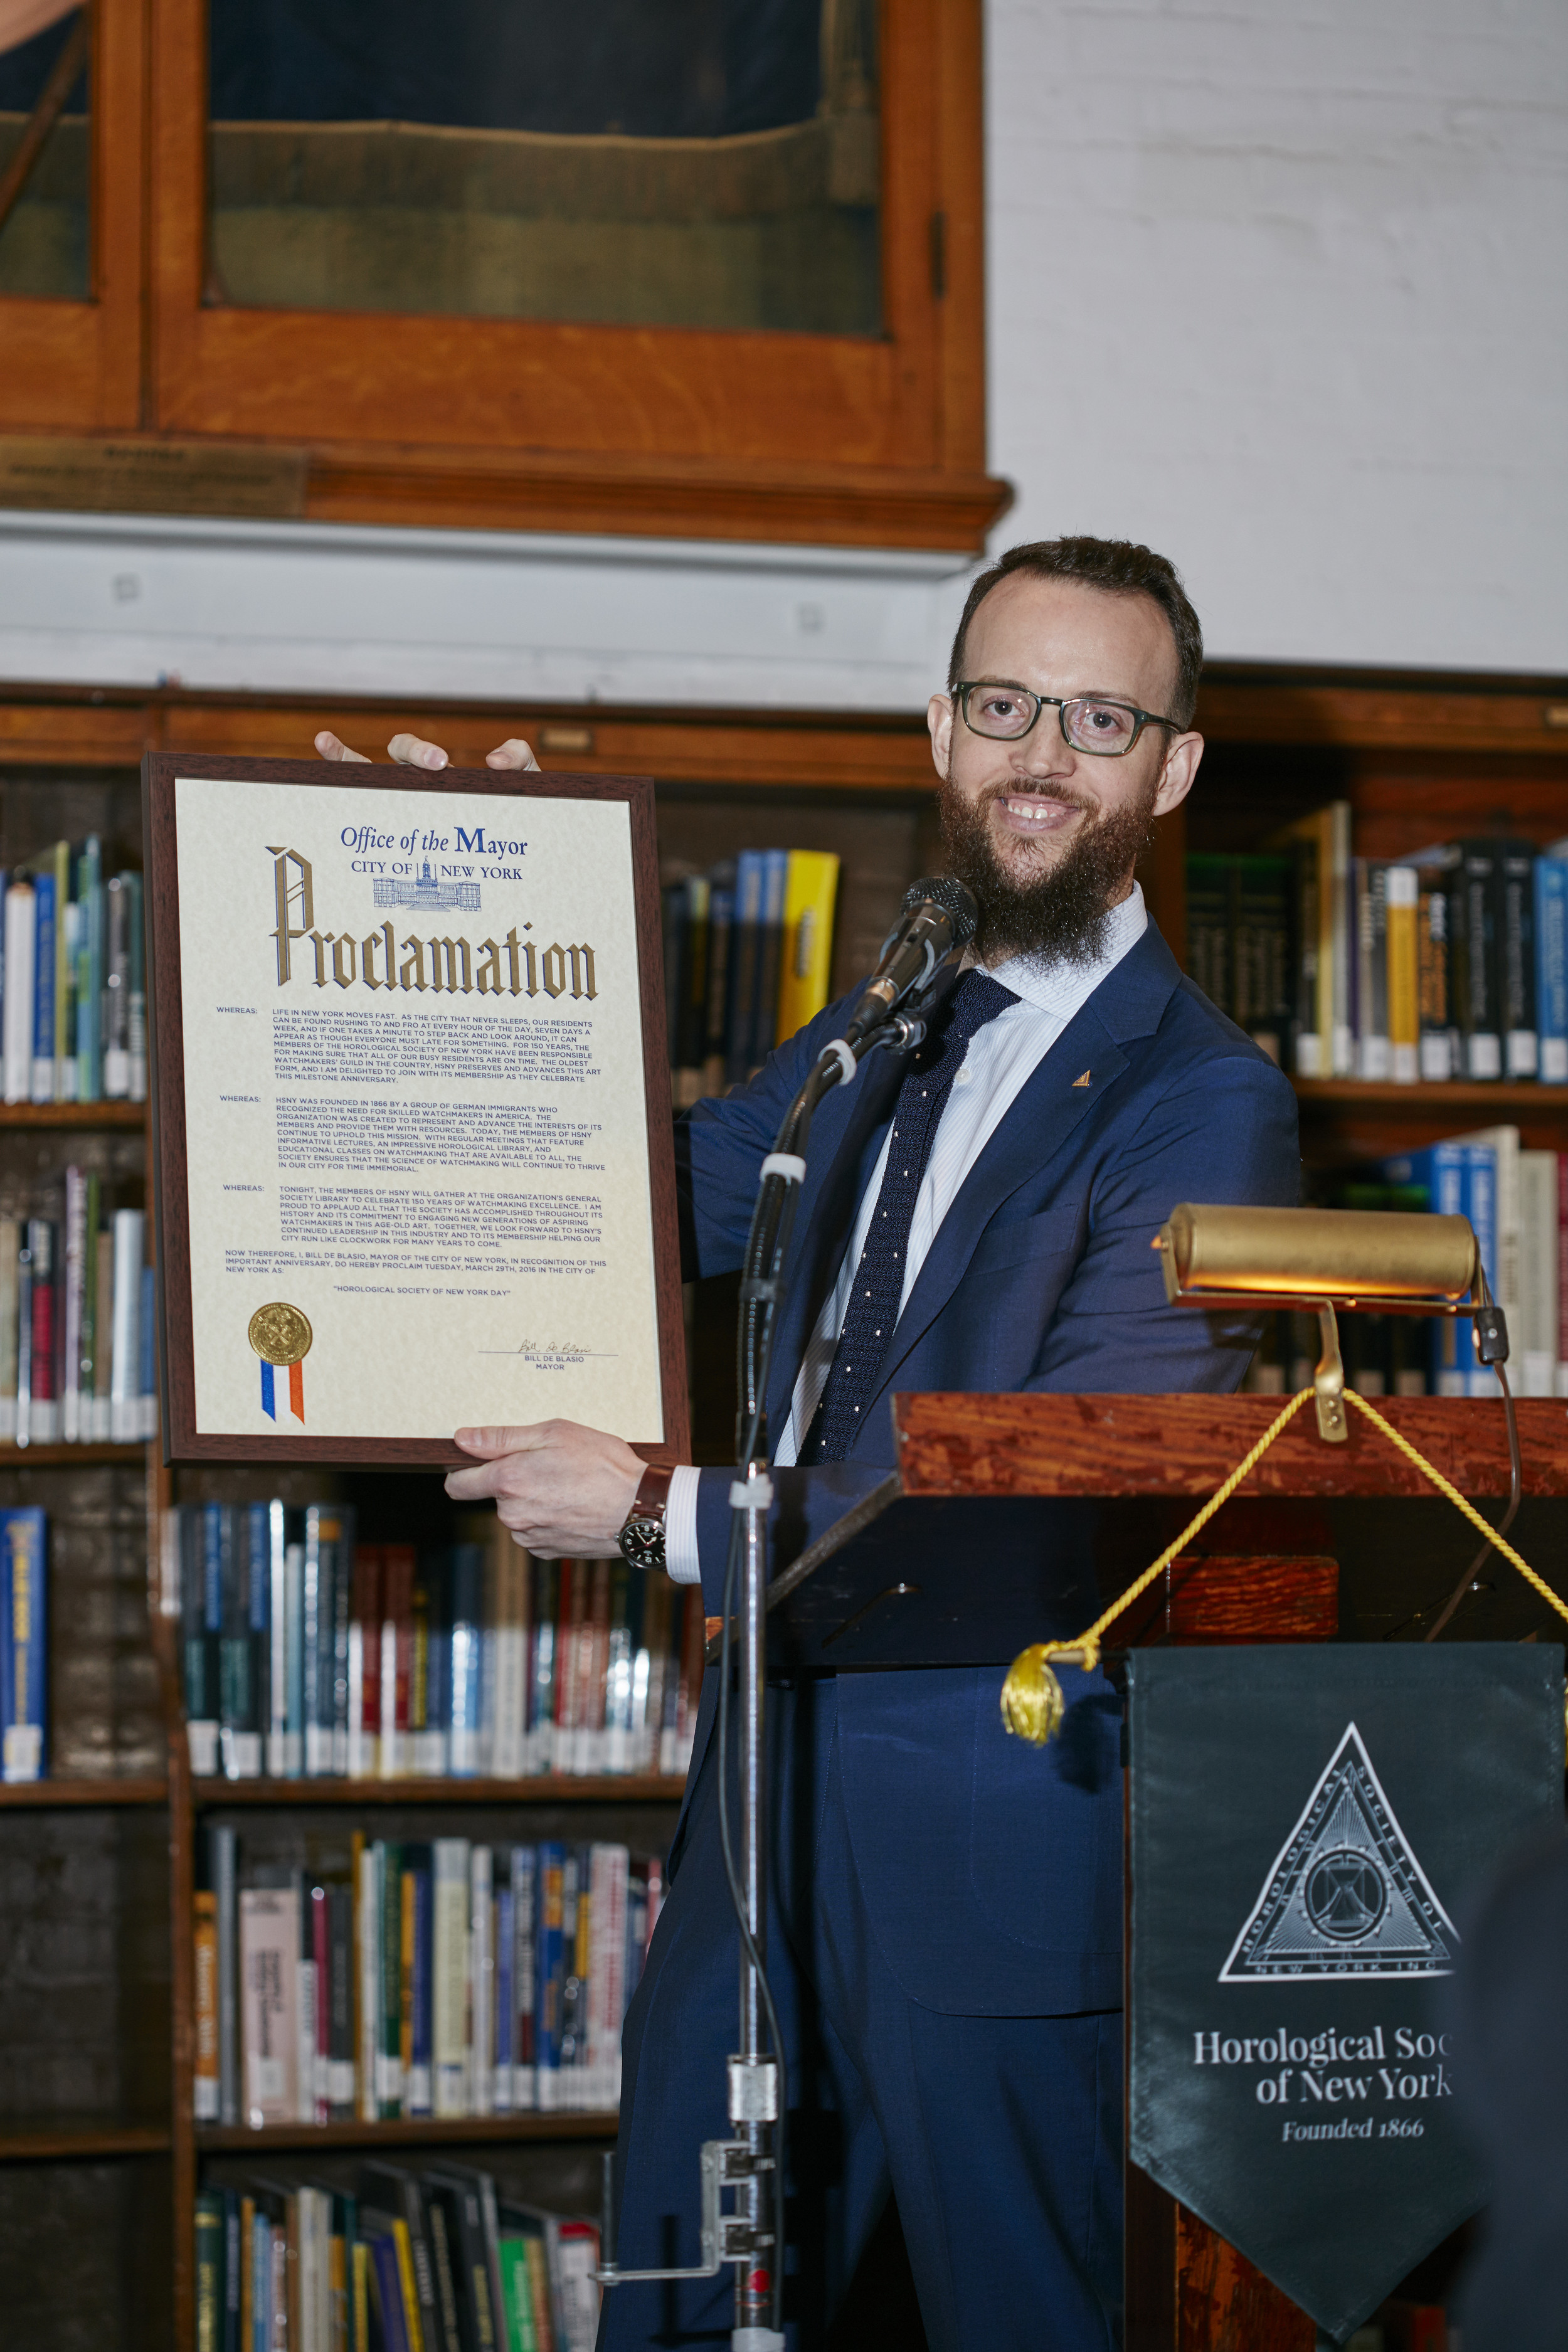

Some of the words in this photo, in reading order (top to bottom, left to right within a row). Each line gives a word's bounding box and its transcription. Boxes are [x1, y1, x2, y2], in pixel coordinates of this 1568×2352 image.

[341, 826, 395, 853] Office
[400, 829, 419, 856] of
[422, 830, 448, 850] the
[454, 827, 527, 860] Mayor
[351, 861, 386, 873] CITY
[392, 862, 413, 874] OF
[440, 865, 475, 877] NEW
[480, 867, 522, 879] YORK
[265, 845, 600, 1001] Proclamation
[500, 1018, 531, 1026] SLEEPS,
[344, 1043, 401, 1052] HOROLOGICAL
[541, 1051, 593, 1059] RESPONSIBLE
[341, 1075, 398, 1083] ANNIVERSARY.
[488, 1104, 536, 1113] IMMIGRANTS
[277, 1113, 337, 1121] ORGANIZATION
[277, 1137, 331, 1145] INFORMATIVE
[334, 1139, 375, 1147] LECTURES,
[438, 1143, 495, 1151] HOROLOGICAL
[497, 1145, 532, 1153] LIBRARY,
[248, 1250, 297, 1258] THEREFORE,
[425, 1263, 464, 1271] TUESDAY,
[1256, 1964, 1304, 1974] NEW
[1319, 1962, 1382, 1973] YORK
[1194, 2025, 1387, 2069] Horological
[1394, 2026, 1453, 2059] Soc
[1256, 2068, 1293, 2104] of
[1300, 2070, 1373, 2103] New
[1378, 2063, 1453, 2100] York
[1282, 2117, 1374, 2143] Founded
[1379, 2118, 1424, 2138] 1866
